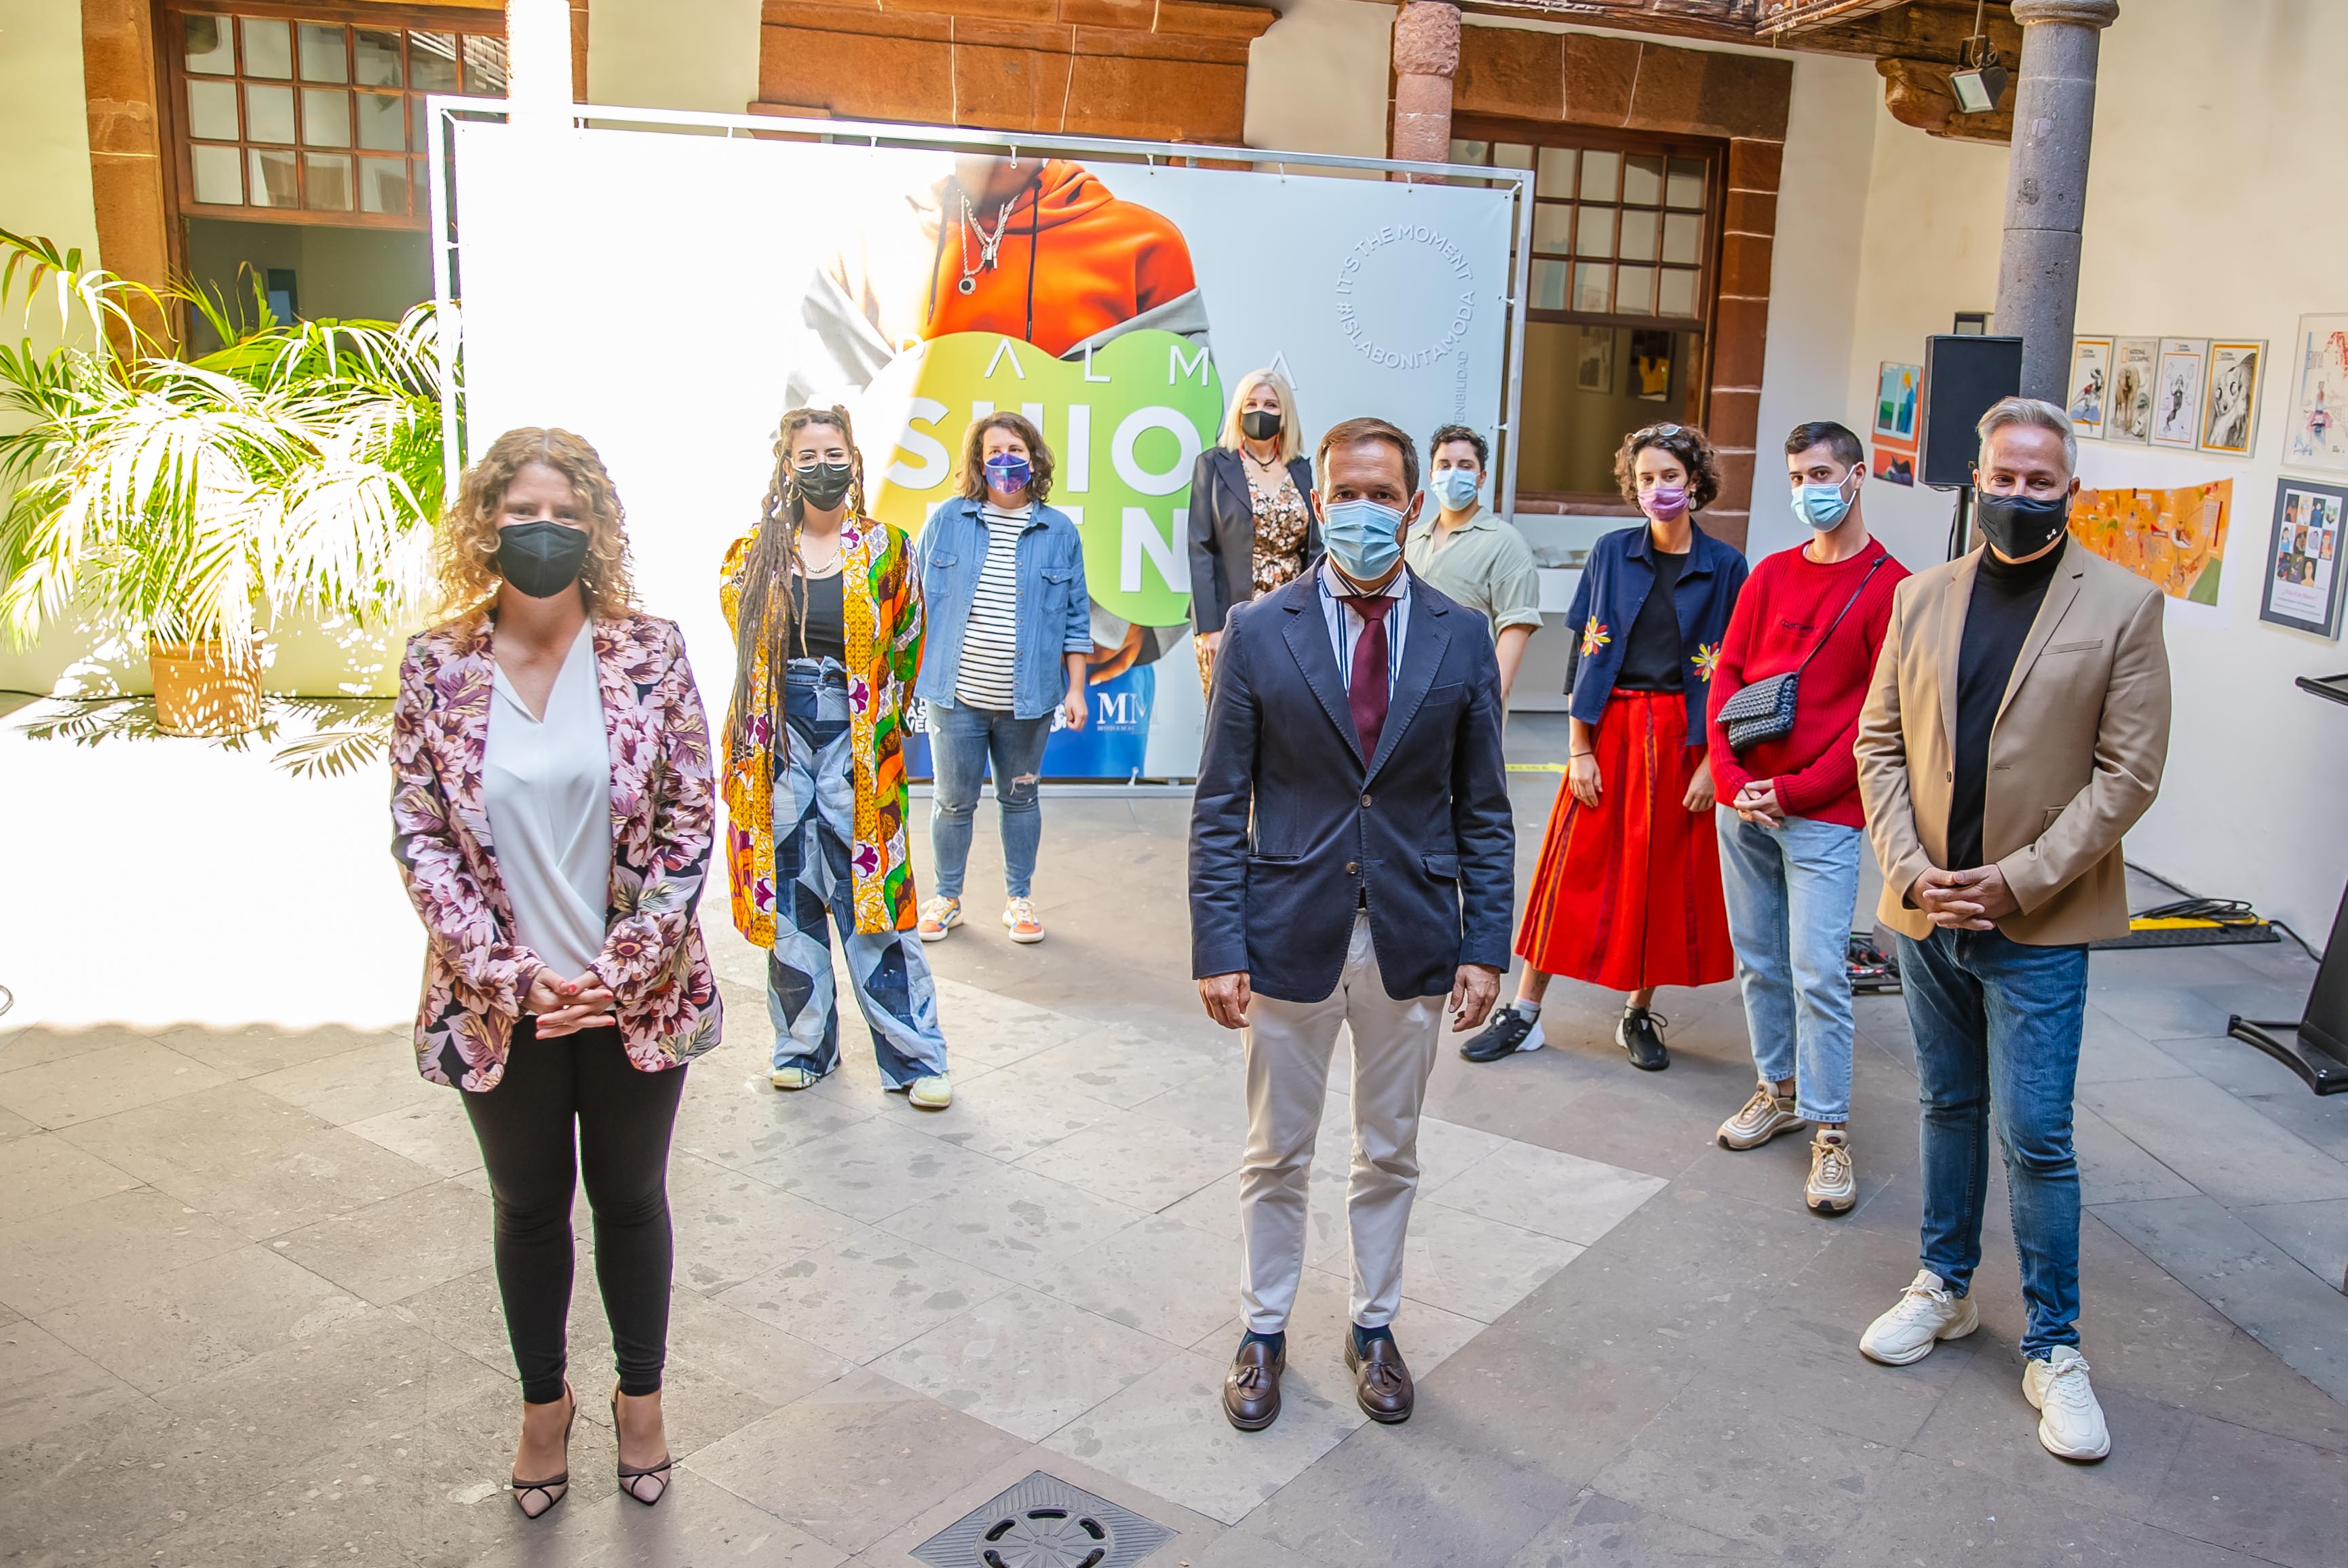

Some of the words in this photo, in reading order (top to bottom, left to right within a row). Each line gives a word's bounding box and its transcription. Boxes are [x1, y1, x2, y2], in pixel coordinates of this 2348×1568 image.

[1354, 226, 1395, 257] THE
[1397, 224, 1474, 280] MOMENT
[1336, 290, 1476, 370] #ISLABONITAMODA
